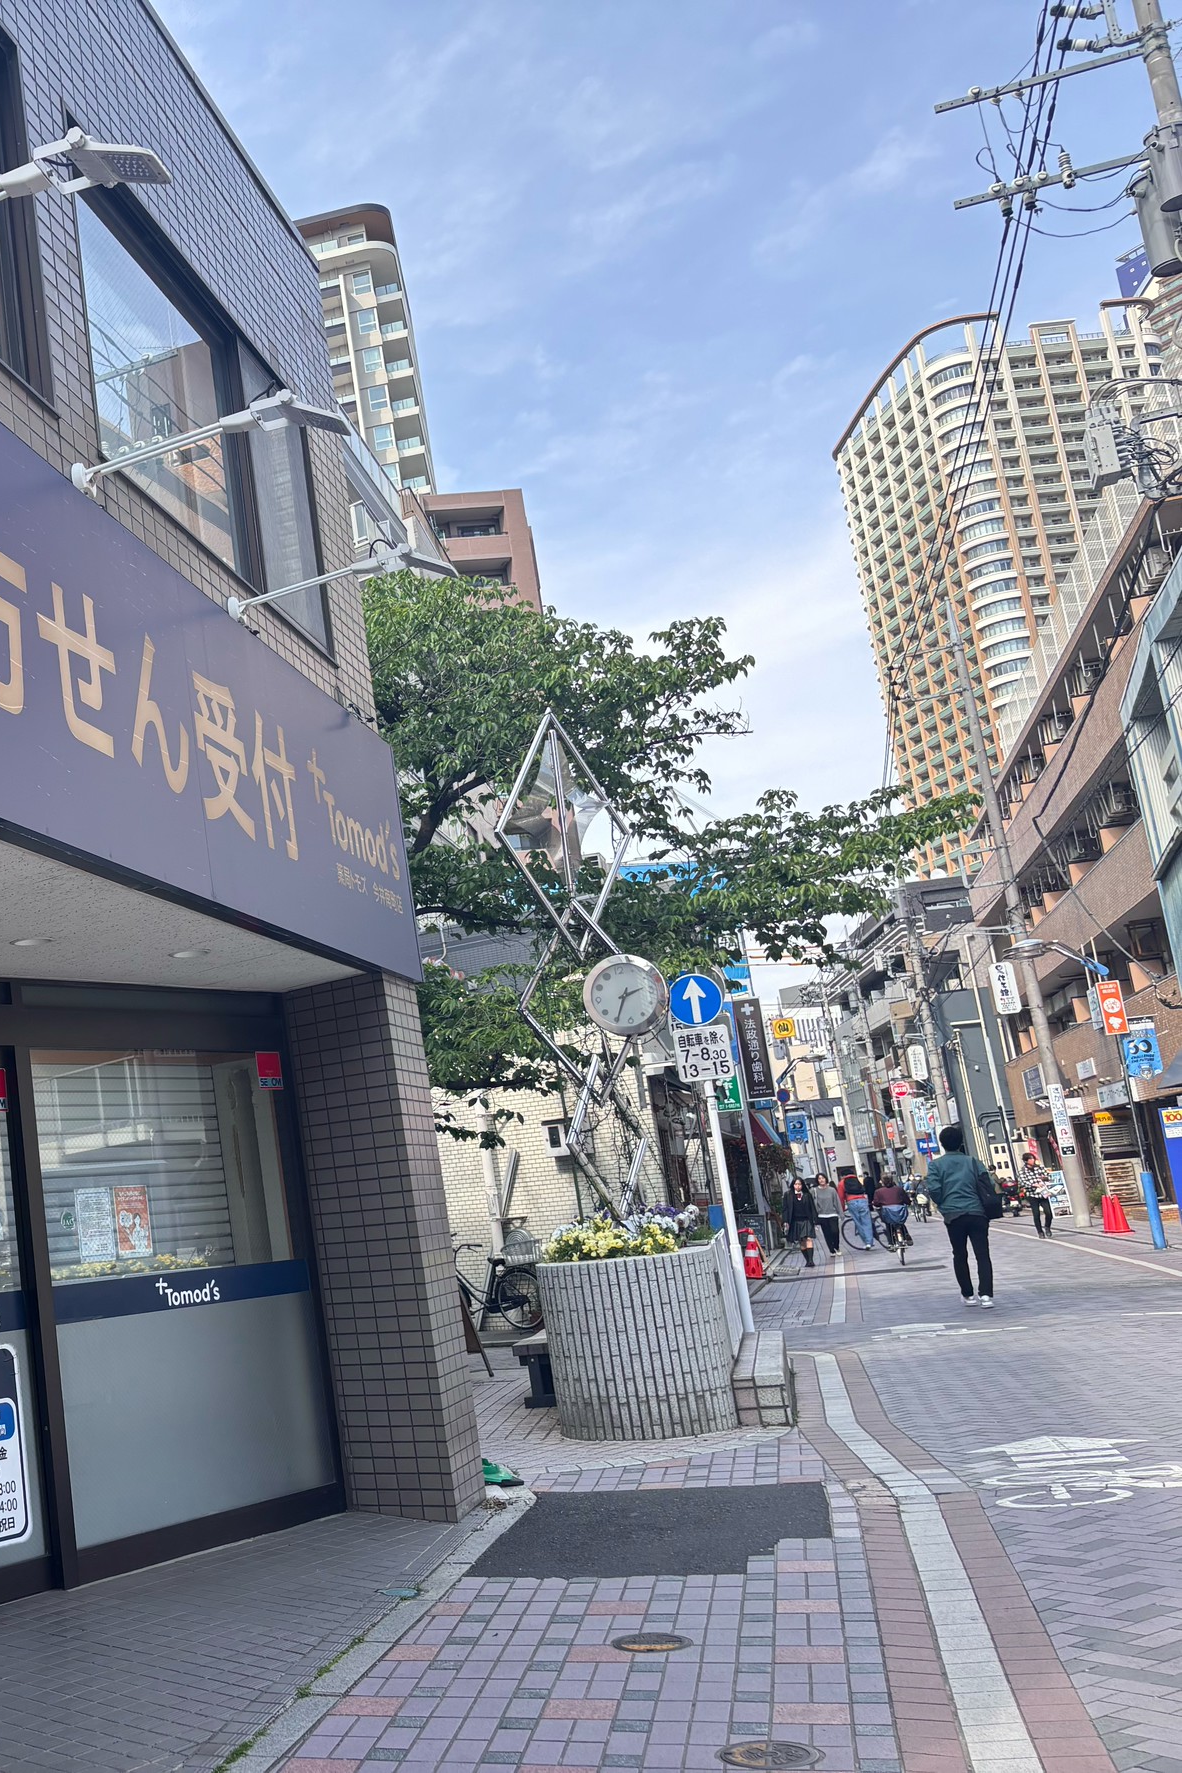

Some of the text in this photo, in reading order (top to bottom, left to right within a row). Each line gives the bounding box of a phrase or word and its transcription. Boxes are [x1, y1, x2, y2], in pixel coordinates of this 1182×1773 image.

[323, 790, 401, 881] Tomod's
[678, 1031, 725, 1048] 自転車を除く
[744, 1019, 765, 1083] 法政通り歯科
[165, 1279, 221, 1307] Tomod's
